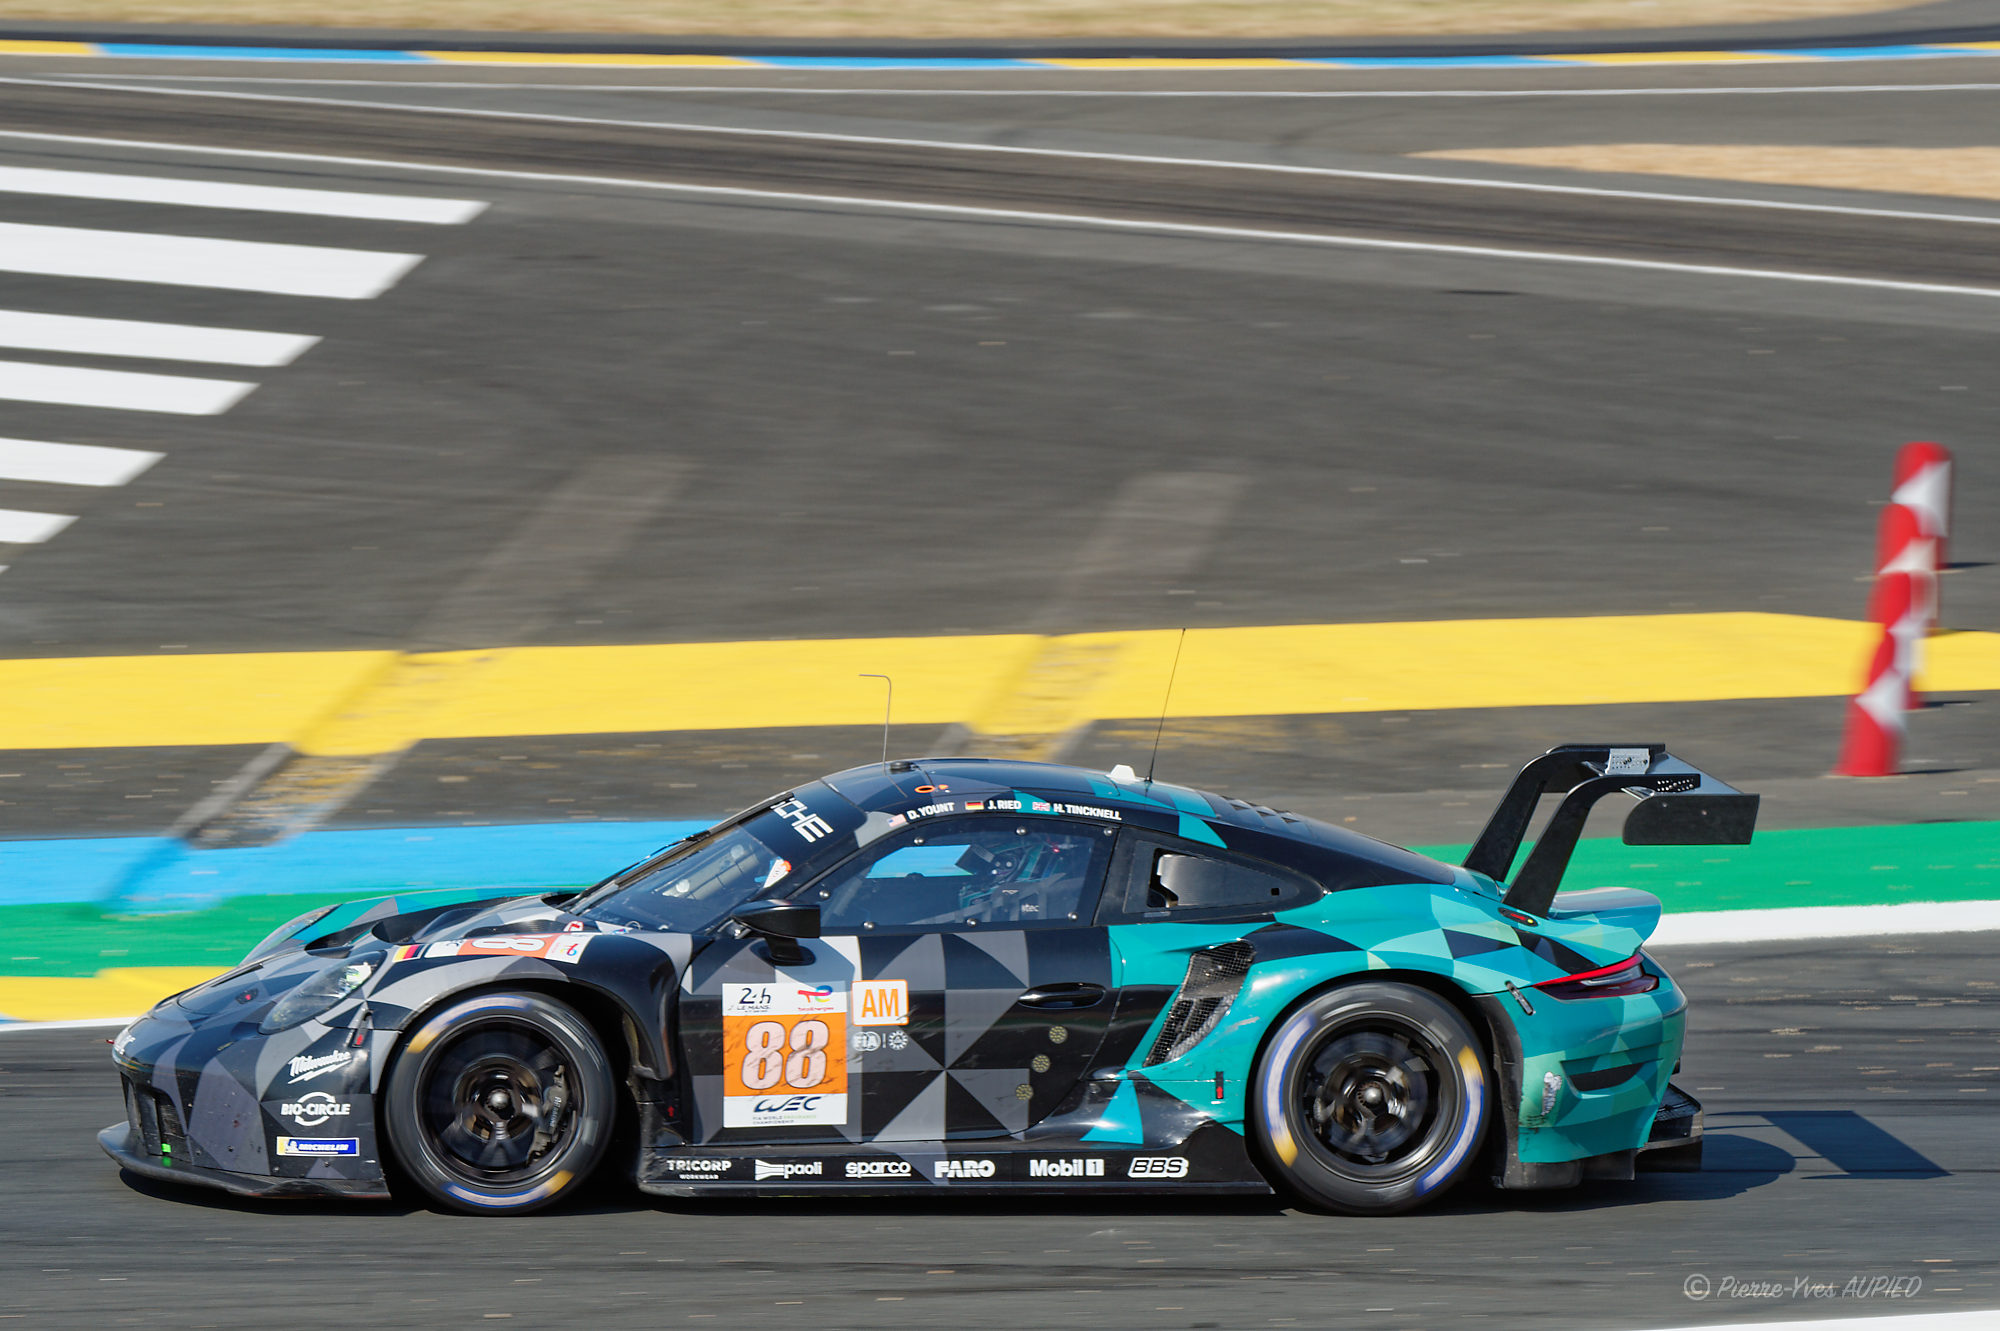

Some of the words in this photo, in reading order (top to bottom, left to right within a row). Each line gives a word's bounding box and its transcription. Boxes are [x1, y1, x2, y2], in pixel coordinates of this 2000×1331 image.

[907, 810, 919, 820] D.
[918, 802, 955, 817] YOUNT
[987, 801, 997, 810] J.
[998, 801, 1022, 810] RIED
[1053, 804, 1065, 813] H.
[1065, 804, 1122, 820] TINCKNELL
[861, 988, 899, 1018] AM
[741, 1019, 829, 1090] 88
[281, 1103, 351, 1115] BIO-CIRCLE
[754, 1096, 822, 1112] WEC
[298, 1143, 349, 1151] MICHELIN
[667, 1160, 732, 1172] TRICORP
[784, 1161, 823, 1179] paoli
[845, 1161, 911, 1178] sparco
[934, 1160, 996, 1178] FARO
[1030, 1159, 1083, 1177] Mobil
[1129, 1157, 1187, 1177] BBS
